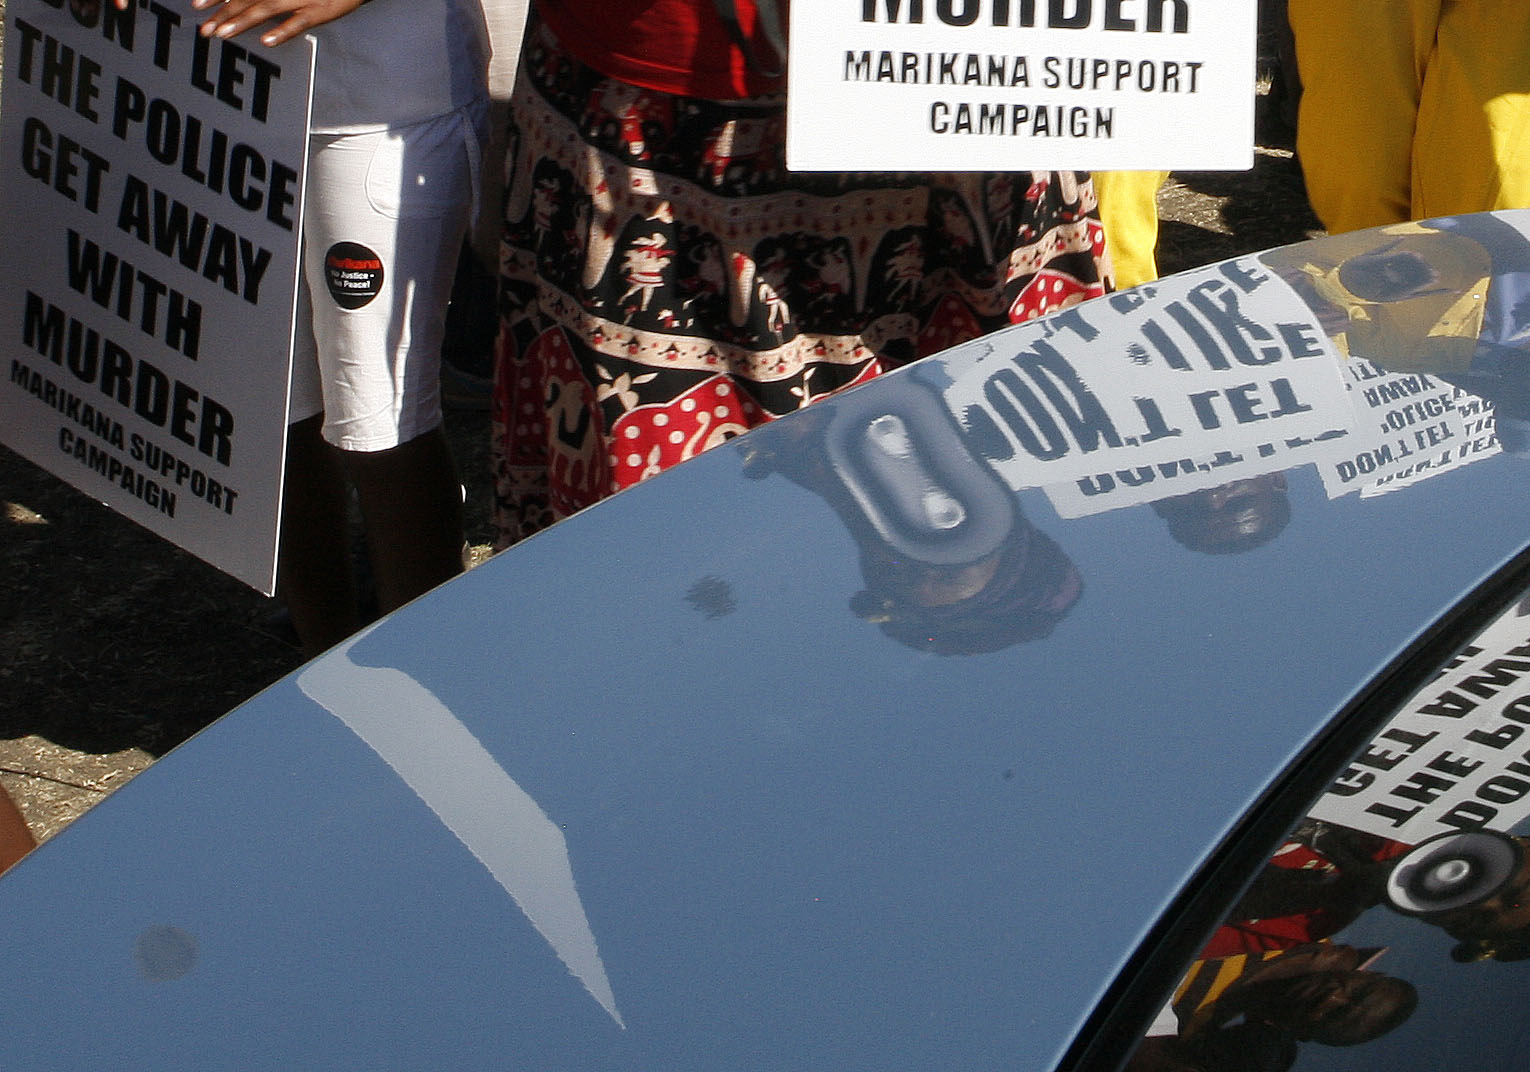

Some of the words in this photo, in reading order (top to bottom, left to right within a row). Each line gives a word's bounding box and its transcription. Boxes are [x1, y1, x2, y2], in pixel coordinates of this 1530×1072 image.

[14, 17, 102, 124] THE
[113, 75, 299, 231] POLICE
[191, 25, 281, 123] LET
[843, 50, 1030, 88] MARIKANA
[1044, 56, 1204, 94] SUPPORT
[930, 102, 1115, 139] CAMPAIGN
[21, 116, 109, 215] GET
[117, 180, 272, 305] AWAY
[66, 228, 202, 362] WITH
[11, 358, 126, 452] MARIKANA
[131, 425, 238, 515] SUPPORT
[23, 290, 235, 467] MURDER
[59, 428, 176, 518] CAMPAIGN
